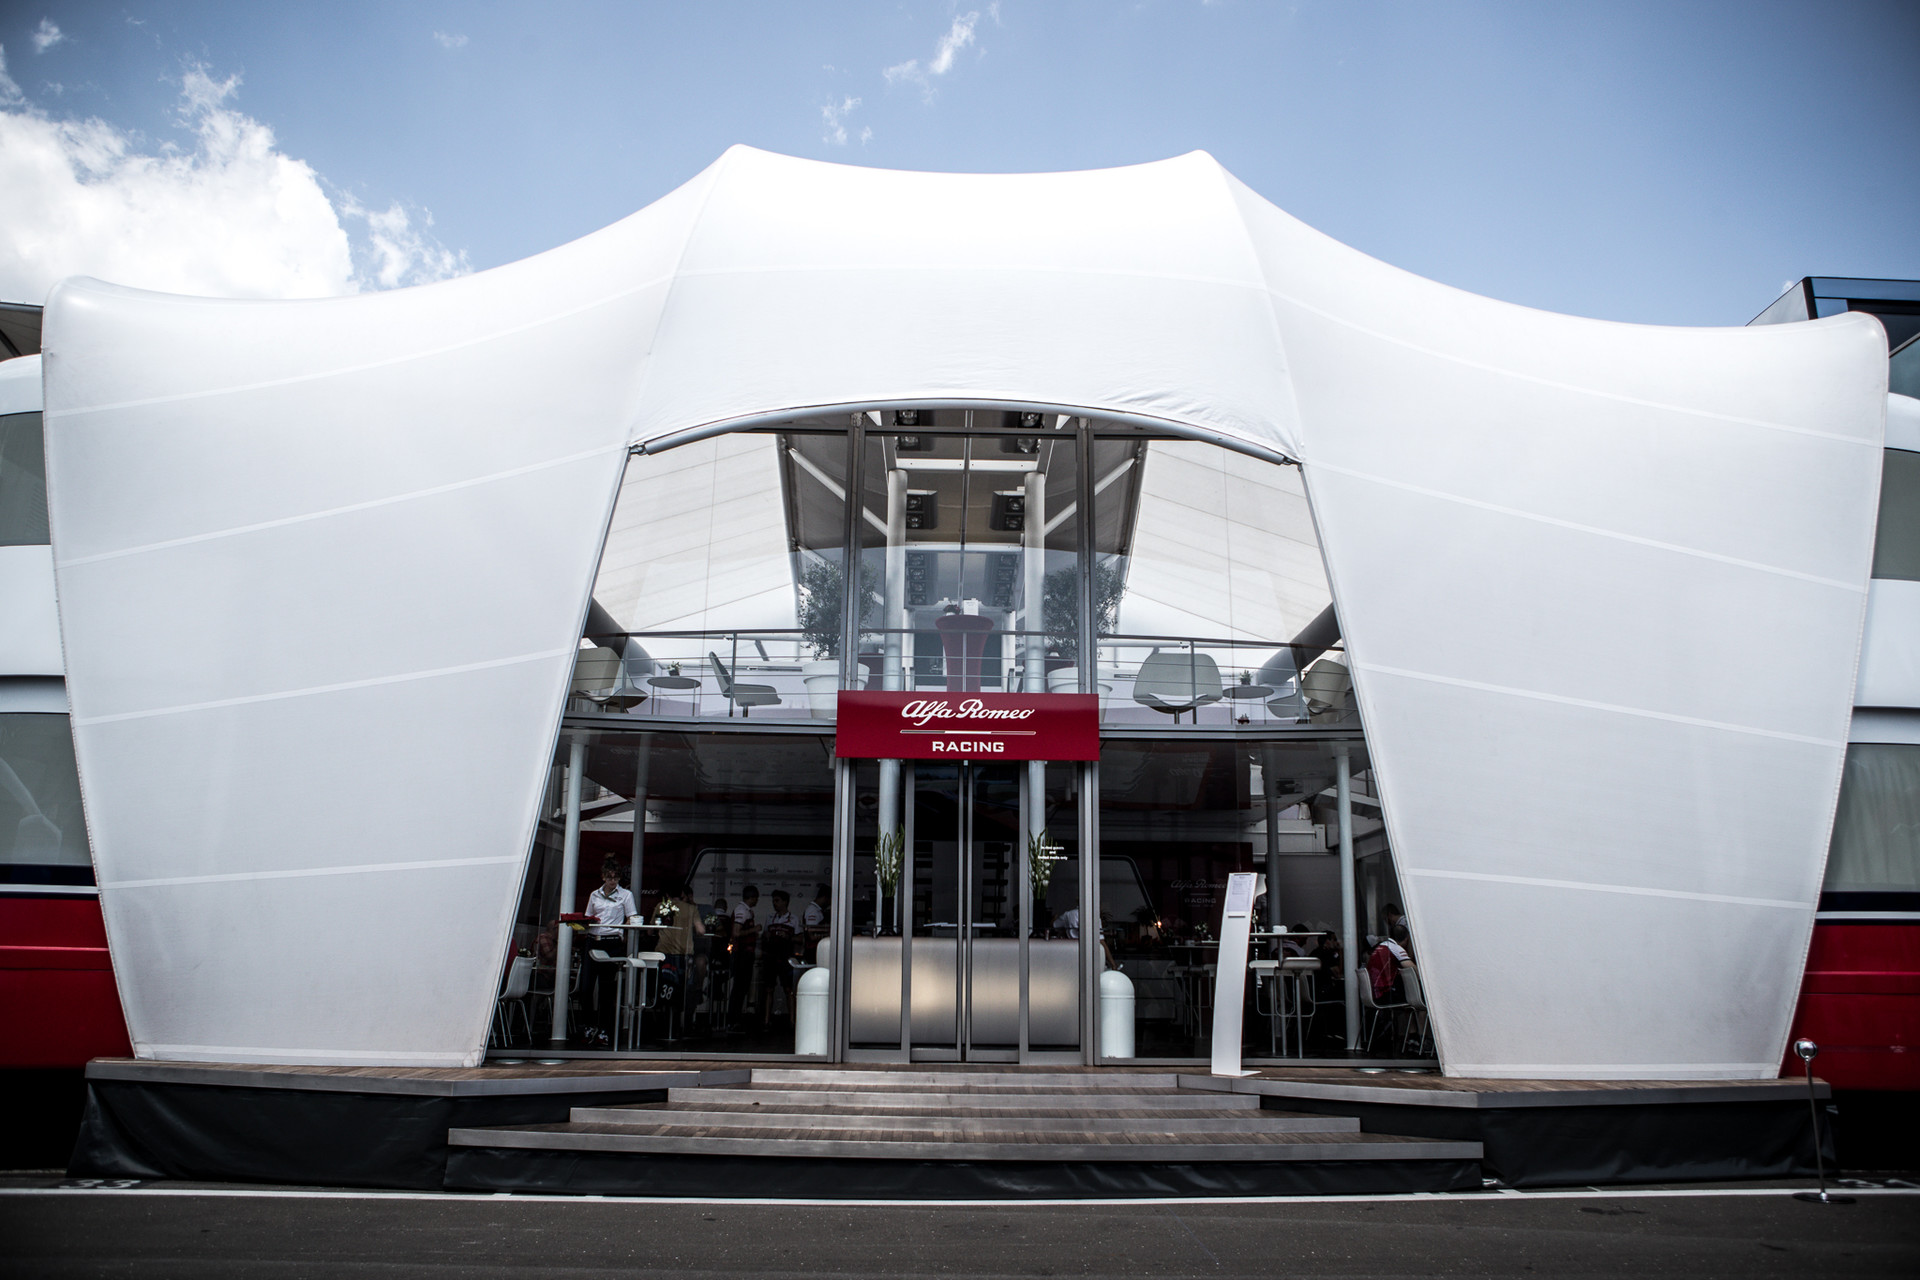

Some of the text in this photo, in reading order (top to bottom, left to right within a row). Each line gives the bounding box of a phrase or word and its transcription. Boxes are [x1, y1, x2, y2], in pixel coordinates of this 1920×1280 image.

[901, 699, 1036, 727] Alfa Romeo
[931, 741, 1005, 753] RACING
[660, 983, 674, 1001] 38
